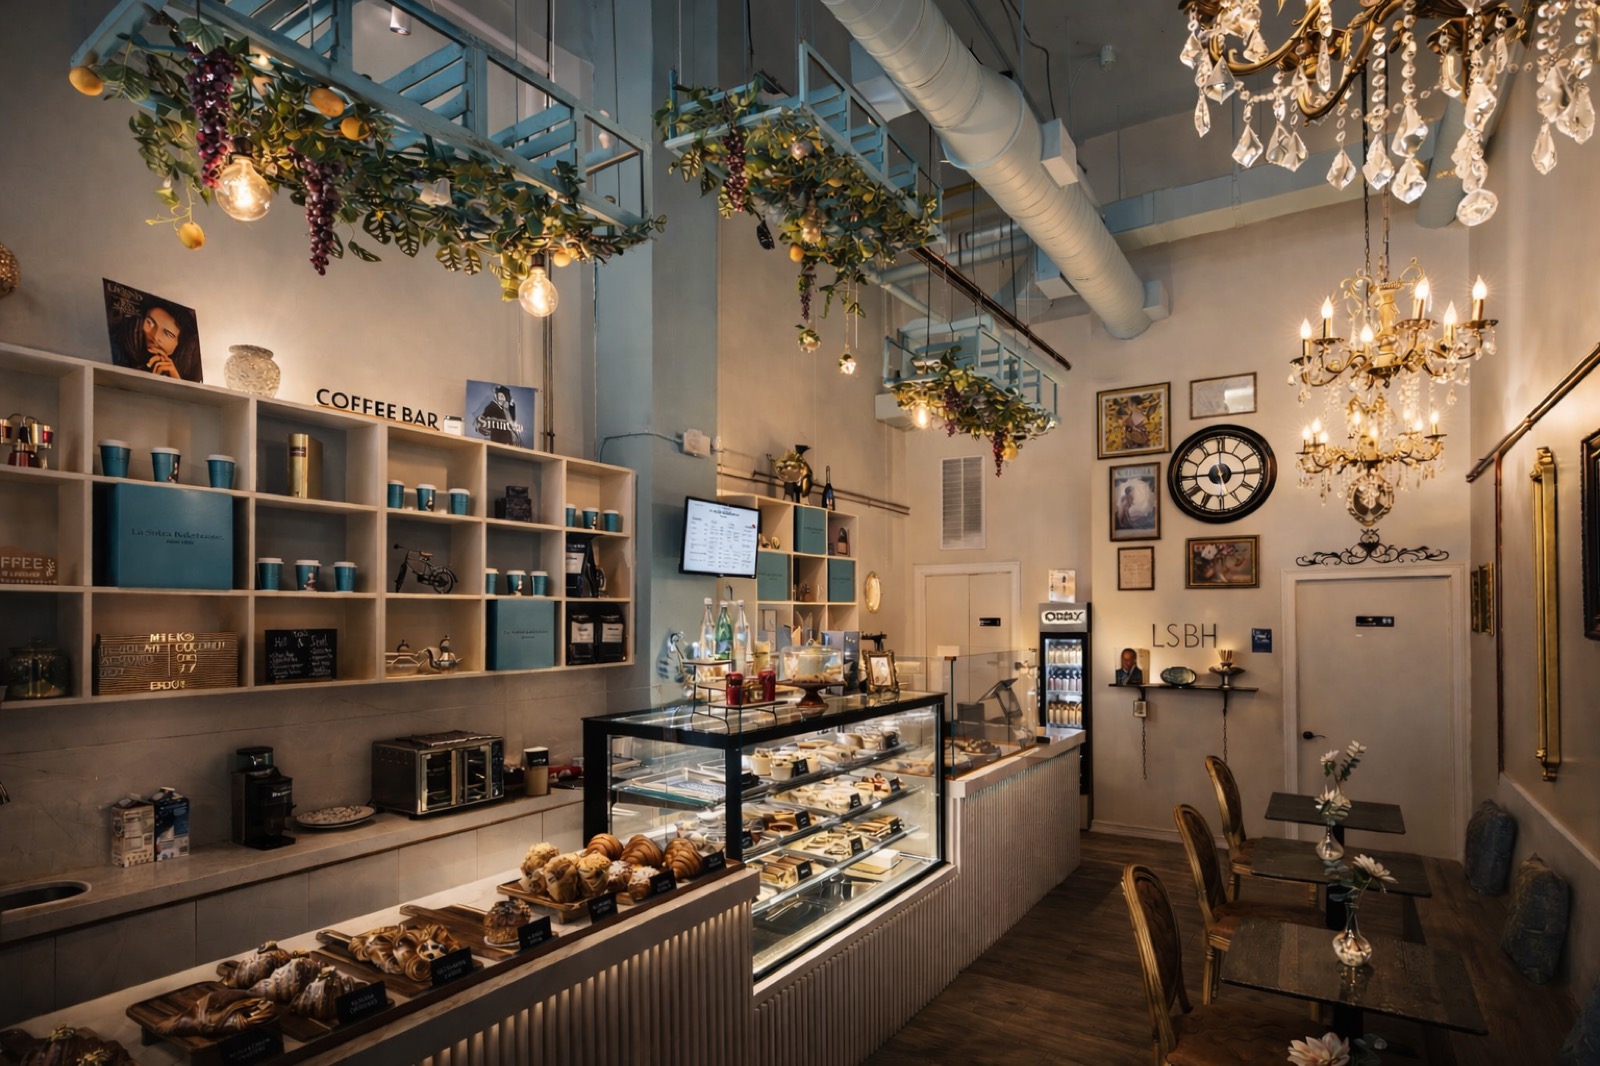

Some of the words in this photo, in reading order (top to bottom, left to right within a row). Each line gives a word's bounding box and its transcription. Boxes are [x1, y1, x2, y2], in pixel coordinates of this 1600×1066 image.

[316, 388, 397, 421] COFFEE
[402, 406, 440, 431] BAR
[1152, 623, 1217, 648] LSBH
